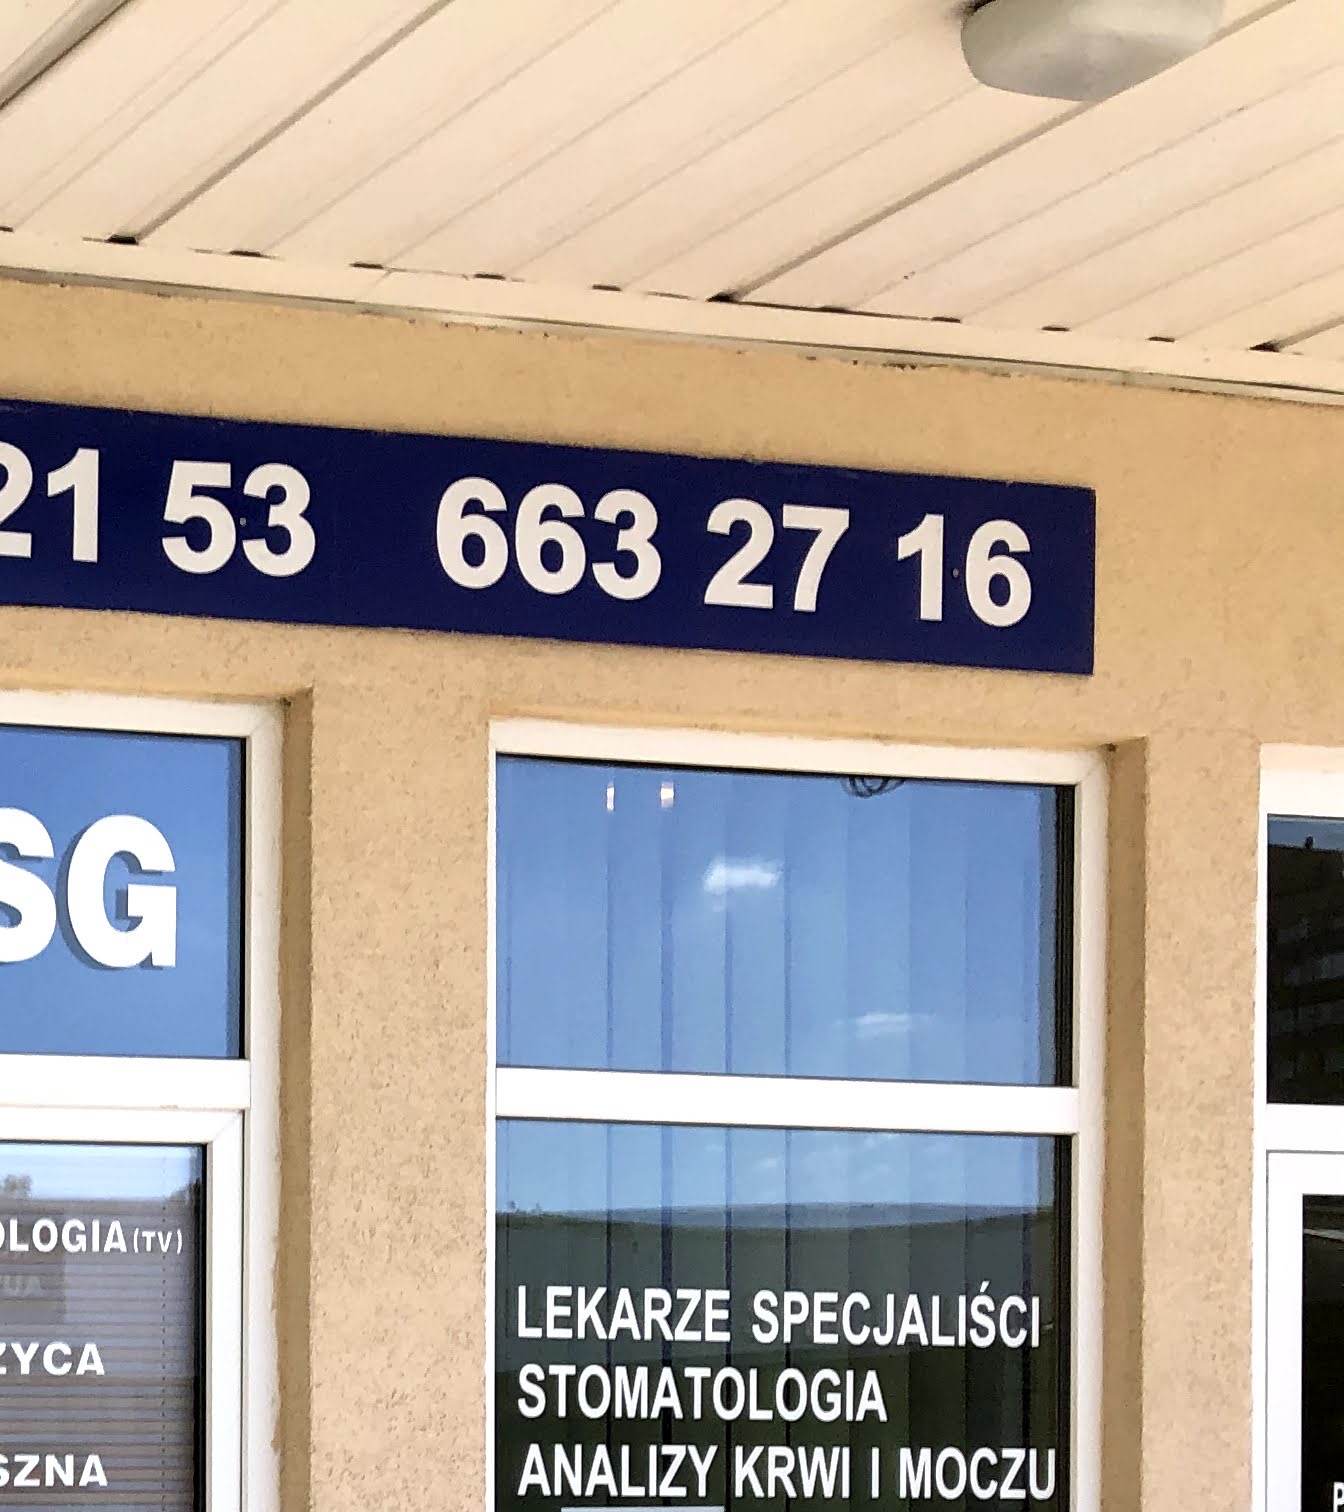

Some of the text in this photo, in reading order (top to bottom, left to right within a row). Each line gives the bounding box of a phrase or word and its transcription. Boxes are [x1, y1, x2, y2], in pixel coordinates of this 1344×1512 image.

[161, 460, 315, 577] 53
[436, 476, 662, 600] 663
[704, 498, 849, 613] 27
[897, 514, 1031, 628] 16
[517, 1281, 1040, 1348] LEKARZE SPECJALIŚCI
[517, 1363, 888, 1422] STOMATOLOGIA
[517, 1443, 1057, 1501] ANALIZY KRWI I MOCZU
